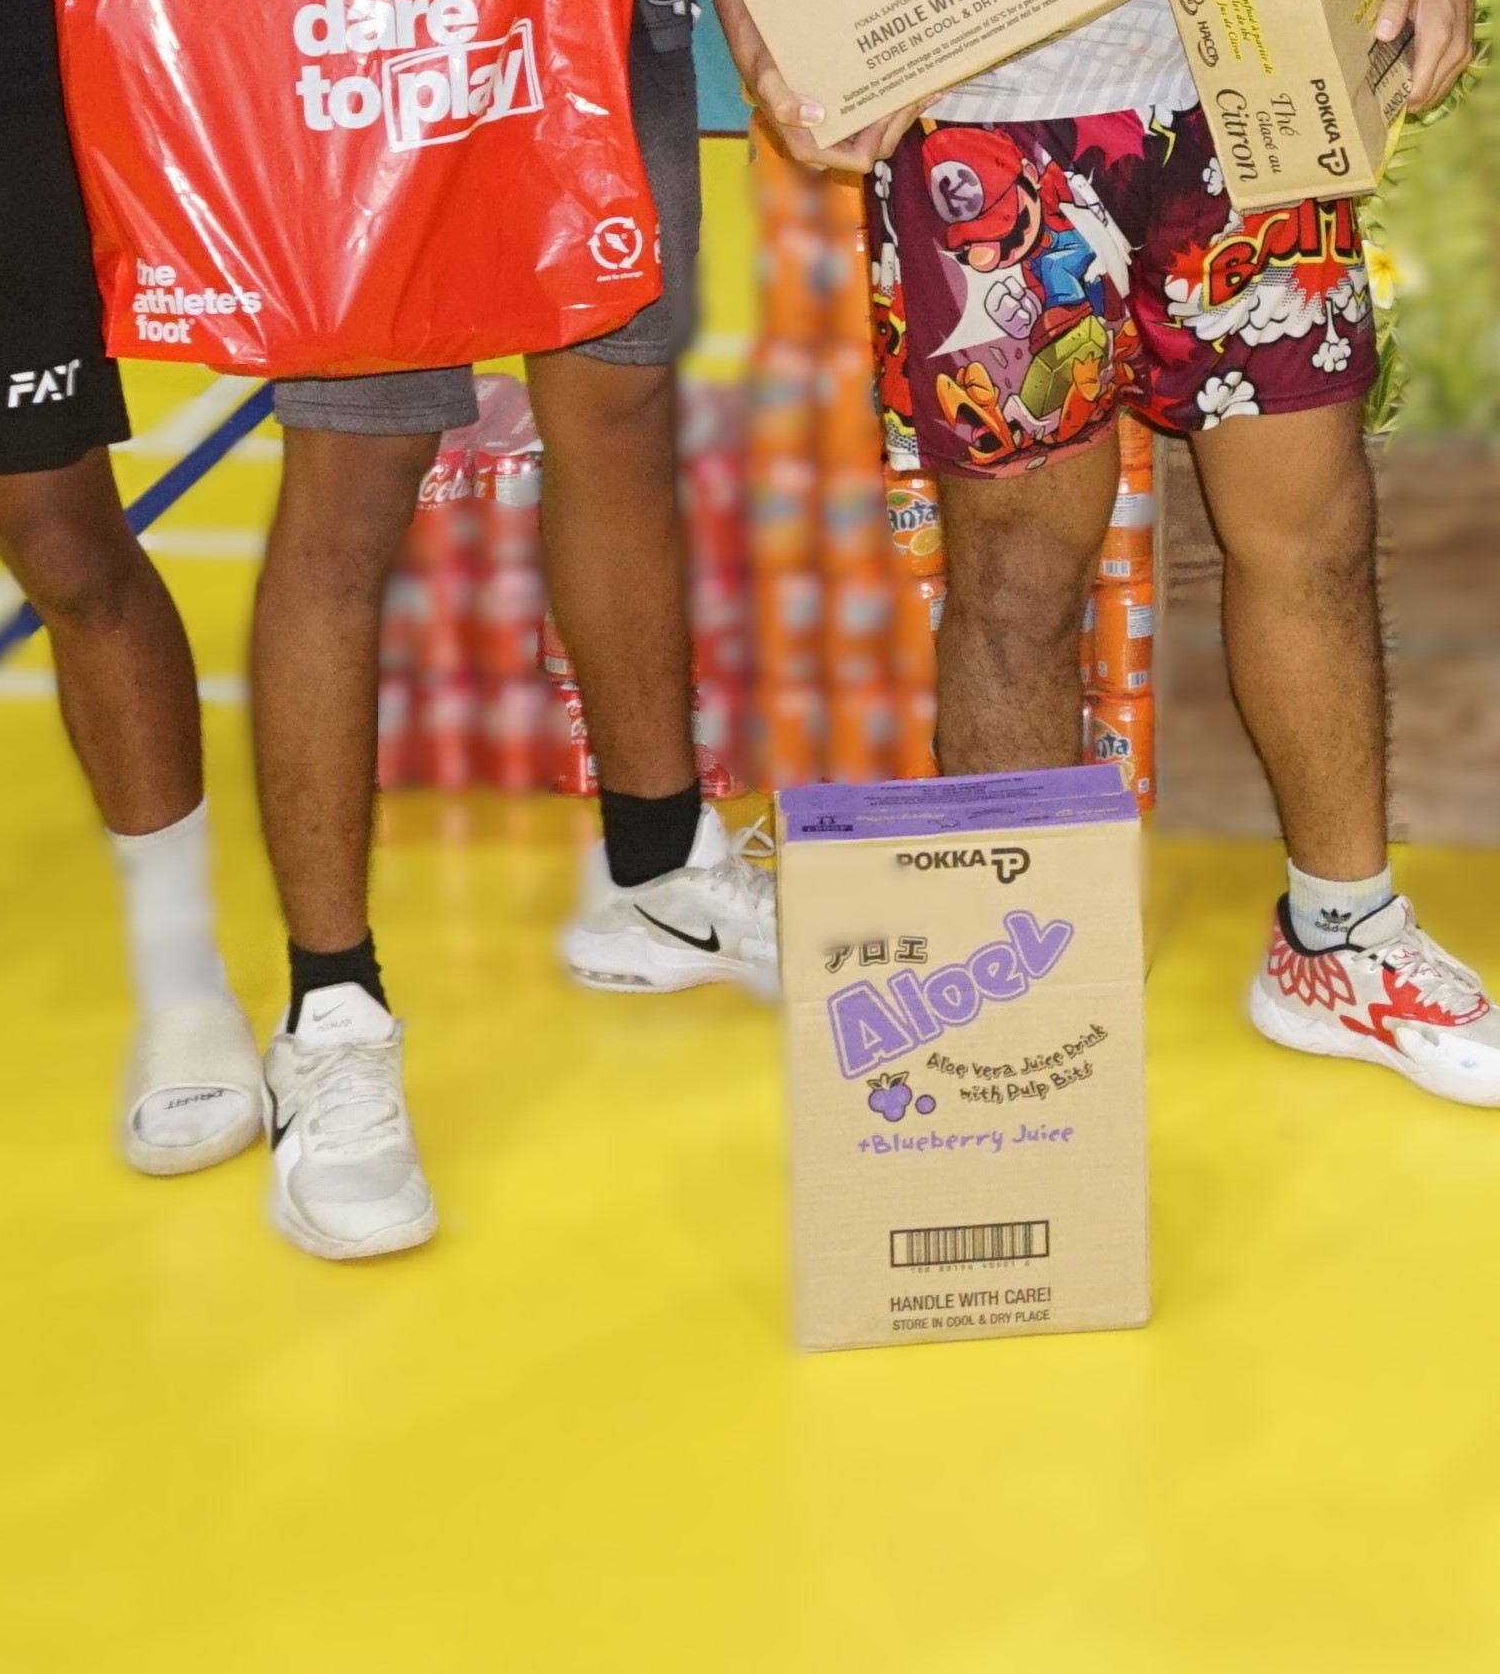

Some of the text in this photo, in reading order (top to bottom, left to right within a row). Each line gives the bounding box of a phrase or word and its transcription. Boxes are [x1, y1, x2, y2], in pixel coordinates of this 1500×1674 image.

[854, 3, 929, 54] HANDLE
[864, 39, 909, 70] STORE
[907, 31, 924, 47] IN
[922, 12, 961, 39] COOL
[959, 6, 973, 20] &
[1196, 18, 1219, 63] HACCP
[296, 44, 524, 142] to play
[1269, 90, 1302, 139] Thé
[1309, 78, 1341, 144] POKKA
[1383, 83, 1412, 119] HANDLE
[1213, 84, 1266, 185] Citron
[1255, 108, 1282, 174] Glacé au
[132, 287, 262, 316] athlete's
[135, 314, 192, 344] foot
[896, 848, 986, 872] POKKA
[926, 1024, 1109, 1076] Aloe Juice Drink
[1006, 1081, 1050, 1101] Pulp
[1050, 1060, 1094, 1091] Bits
[1012, 1125, 1075, 1145] Juice
[890, 1287, 1052, 1312] HANDLE WITH CARE!
[892, 1310, 1051, 1331] STORE IN COOL & DRY PLACE
